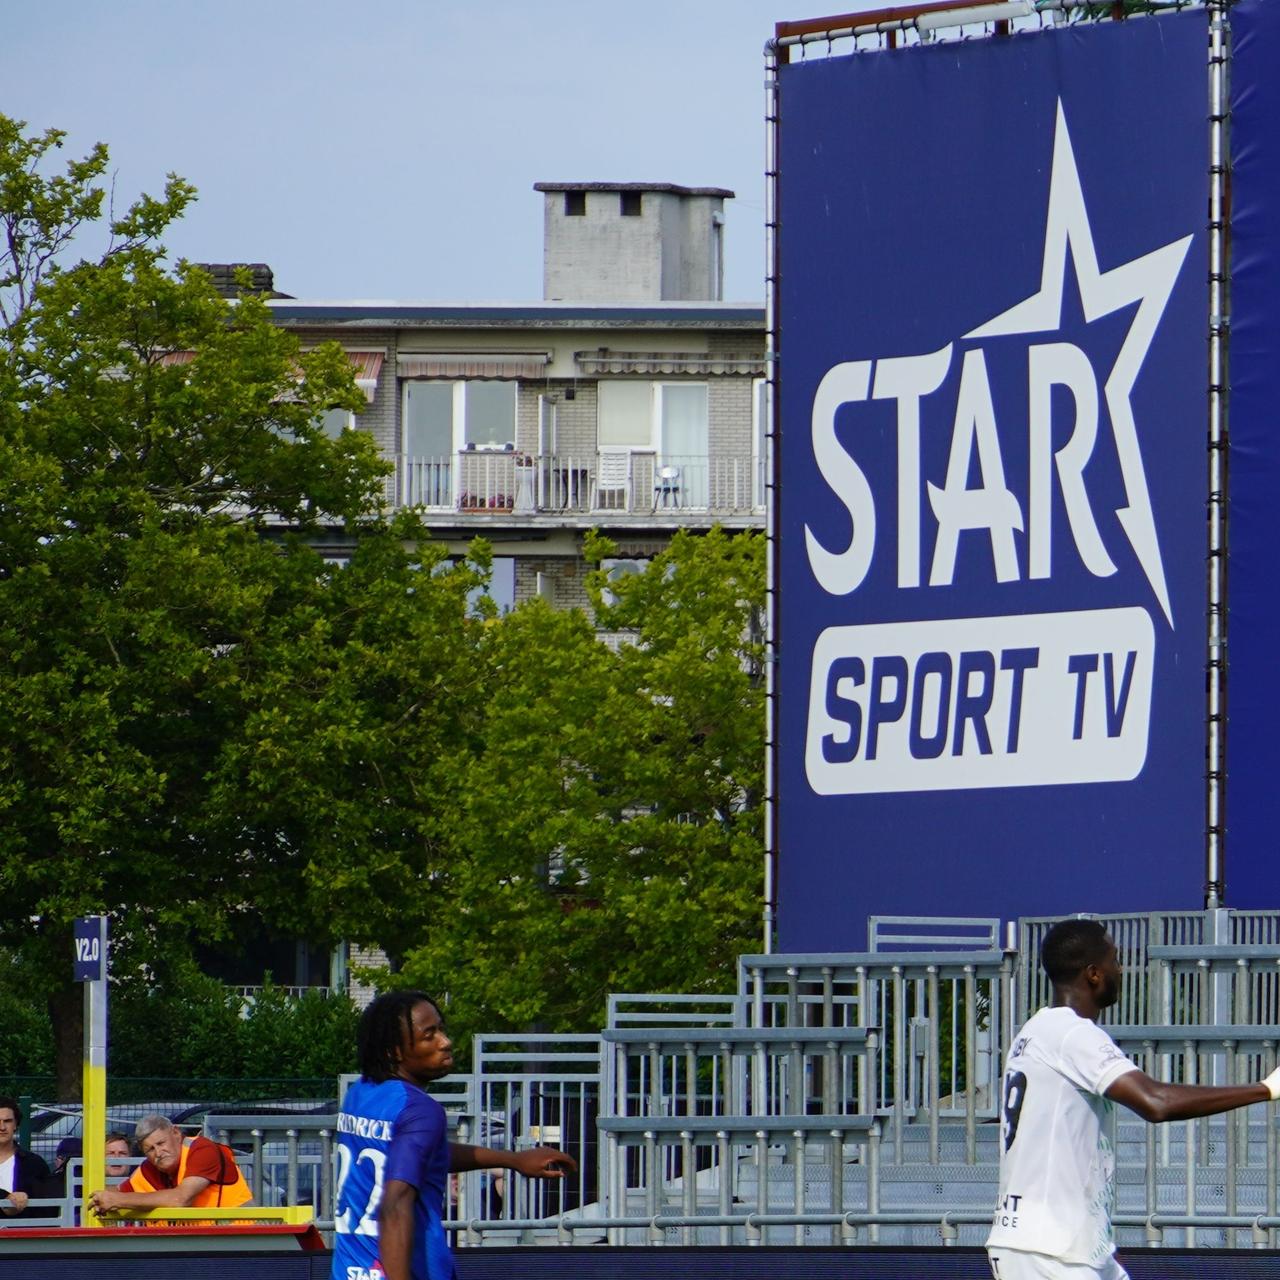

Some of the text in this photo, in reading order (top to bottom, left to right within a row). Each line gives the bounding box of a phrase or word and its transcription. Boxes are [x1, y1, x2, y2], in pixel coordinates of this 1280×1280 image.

[805, 341, 1119, 597] STAR
[820, 648, 1139, 766] SPORT TV
[74, 937, 99, 962] V2.0
[334, 1142, 388, 1237] 22
